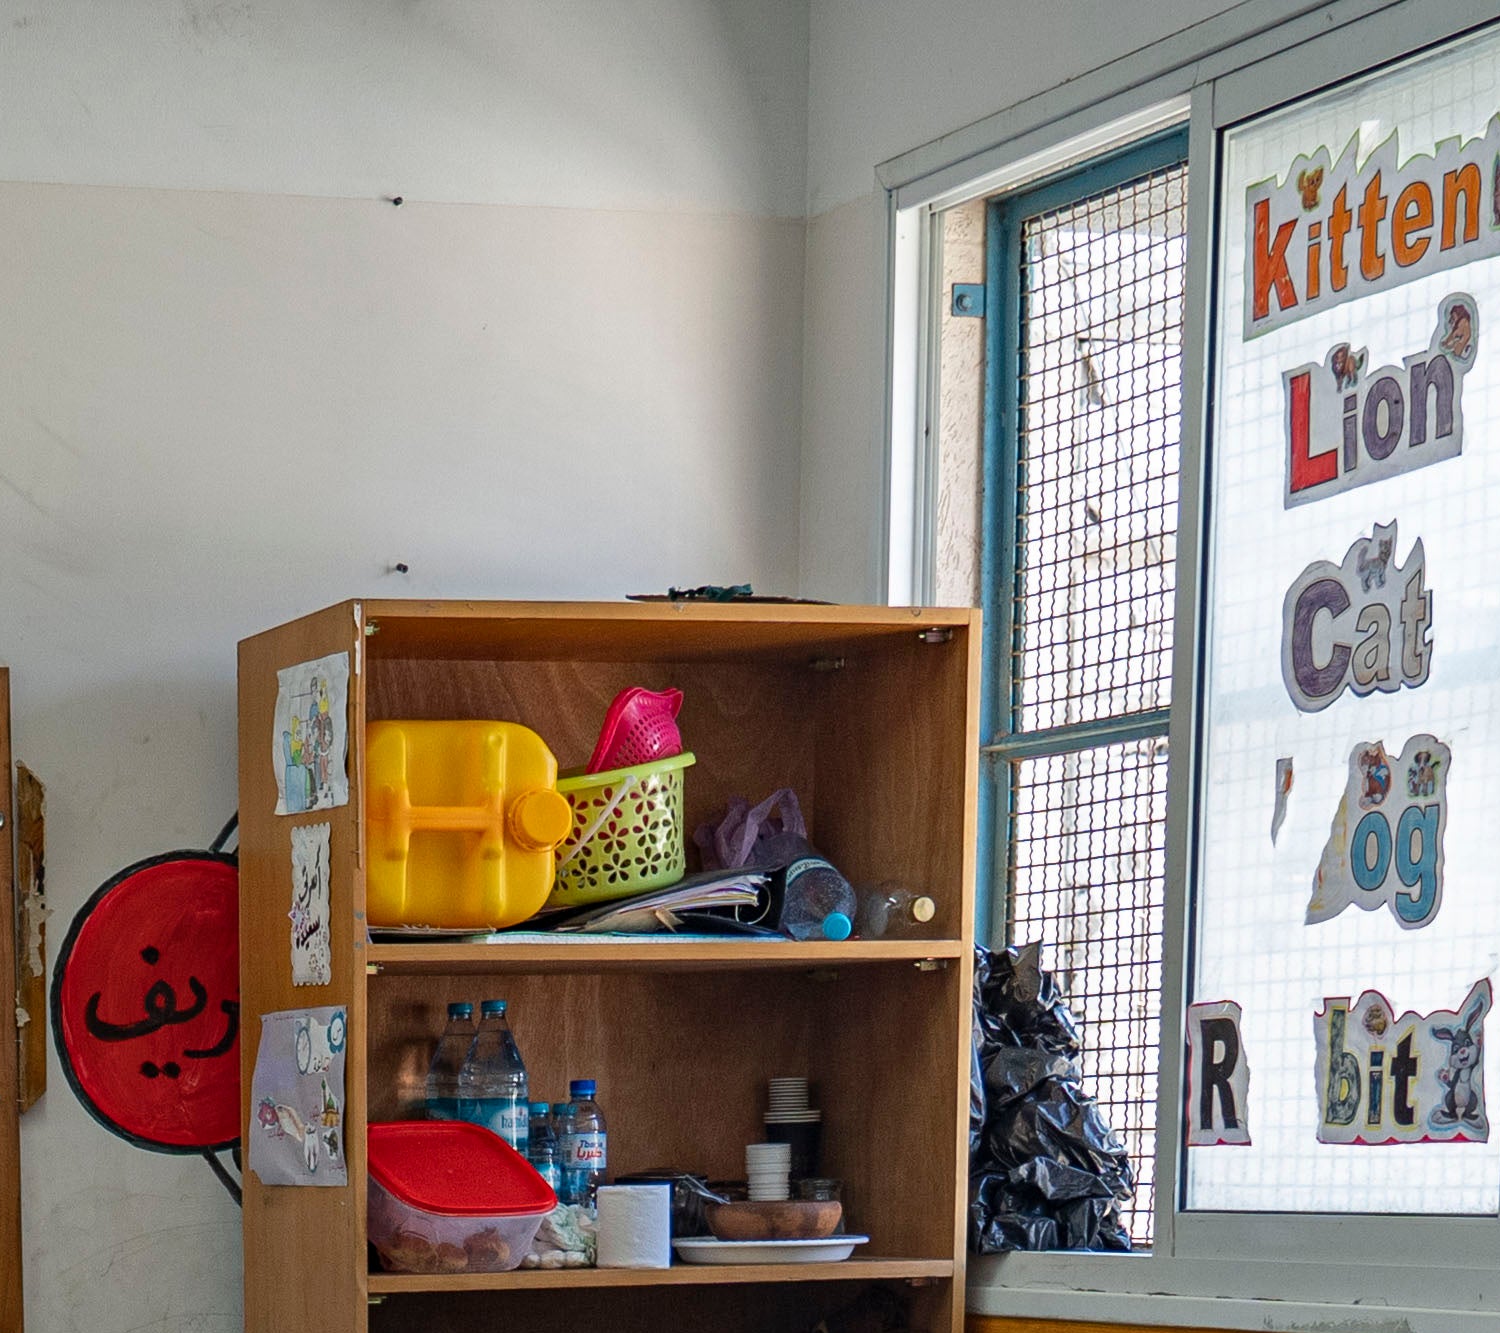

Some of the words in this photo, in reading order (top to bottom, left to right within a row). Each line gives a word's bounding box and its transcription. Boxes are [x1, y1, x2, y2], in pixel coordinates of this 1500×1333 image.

[1289, 354, 1454, 494] Lion
[1291, 575, 1430, 695] Cat
[1350, 803, 1441, 923] og
